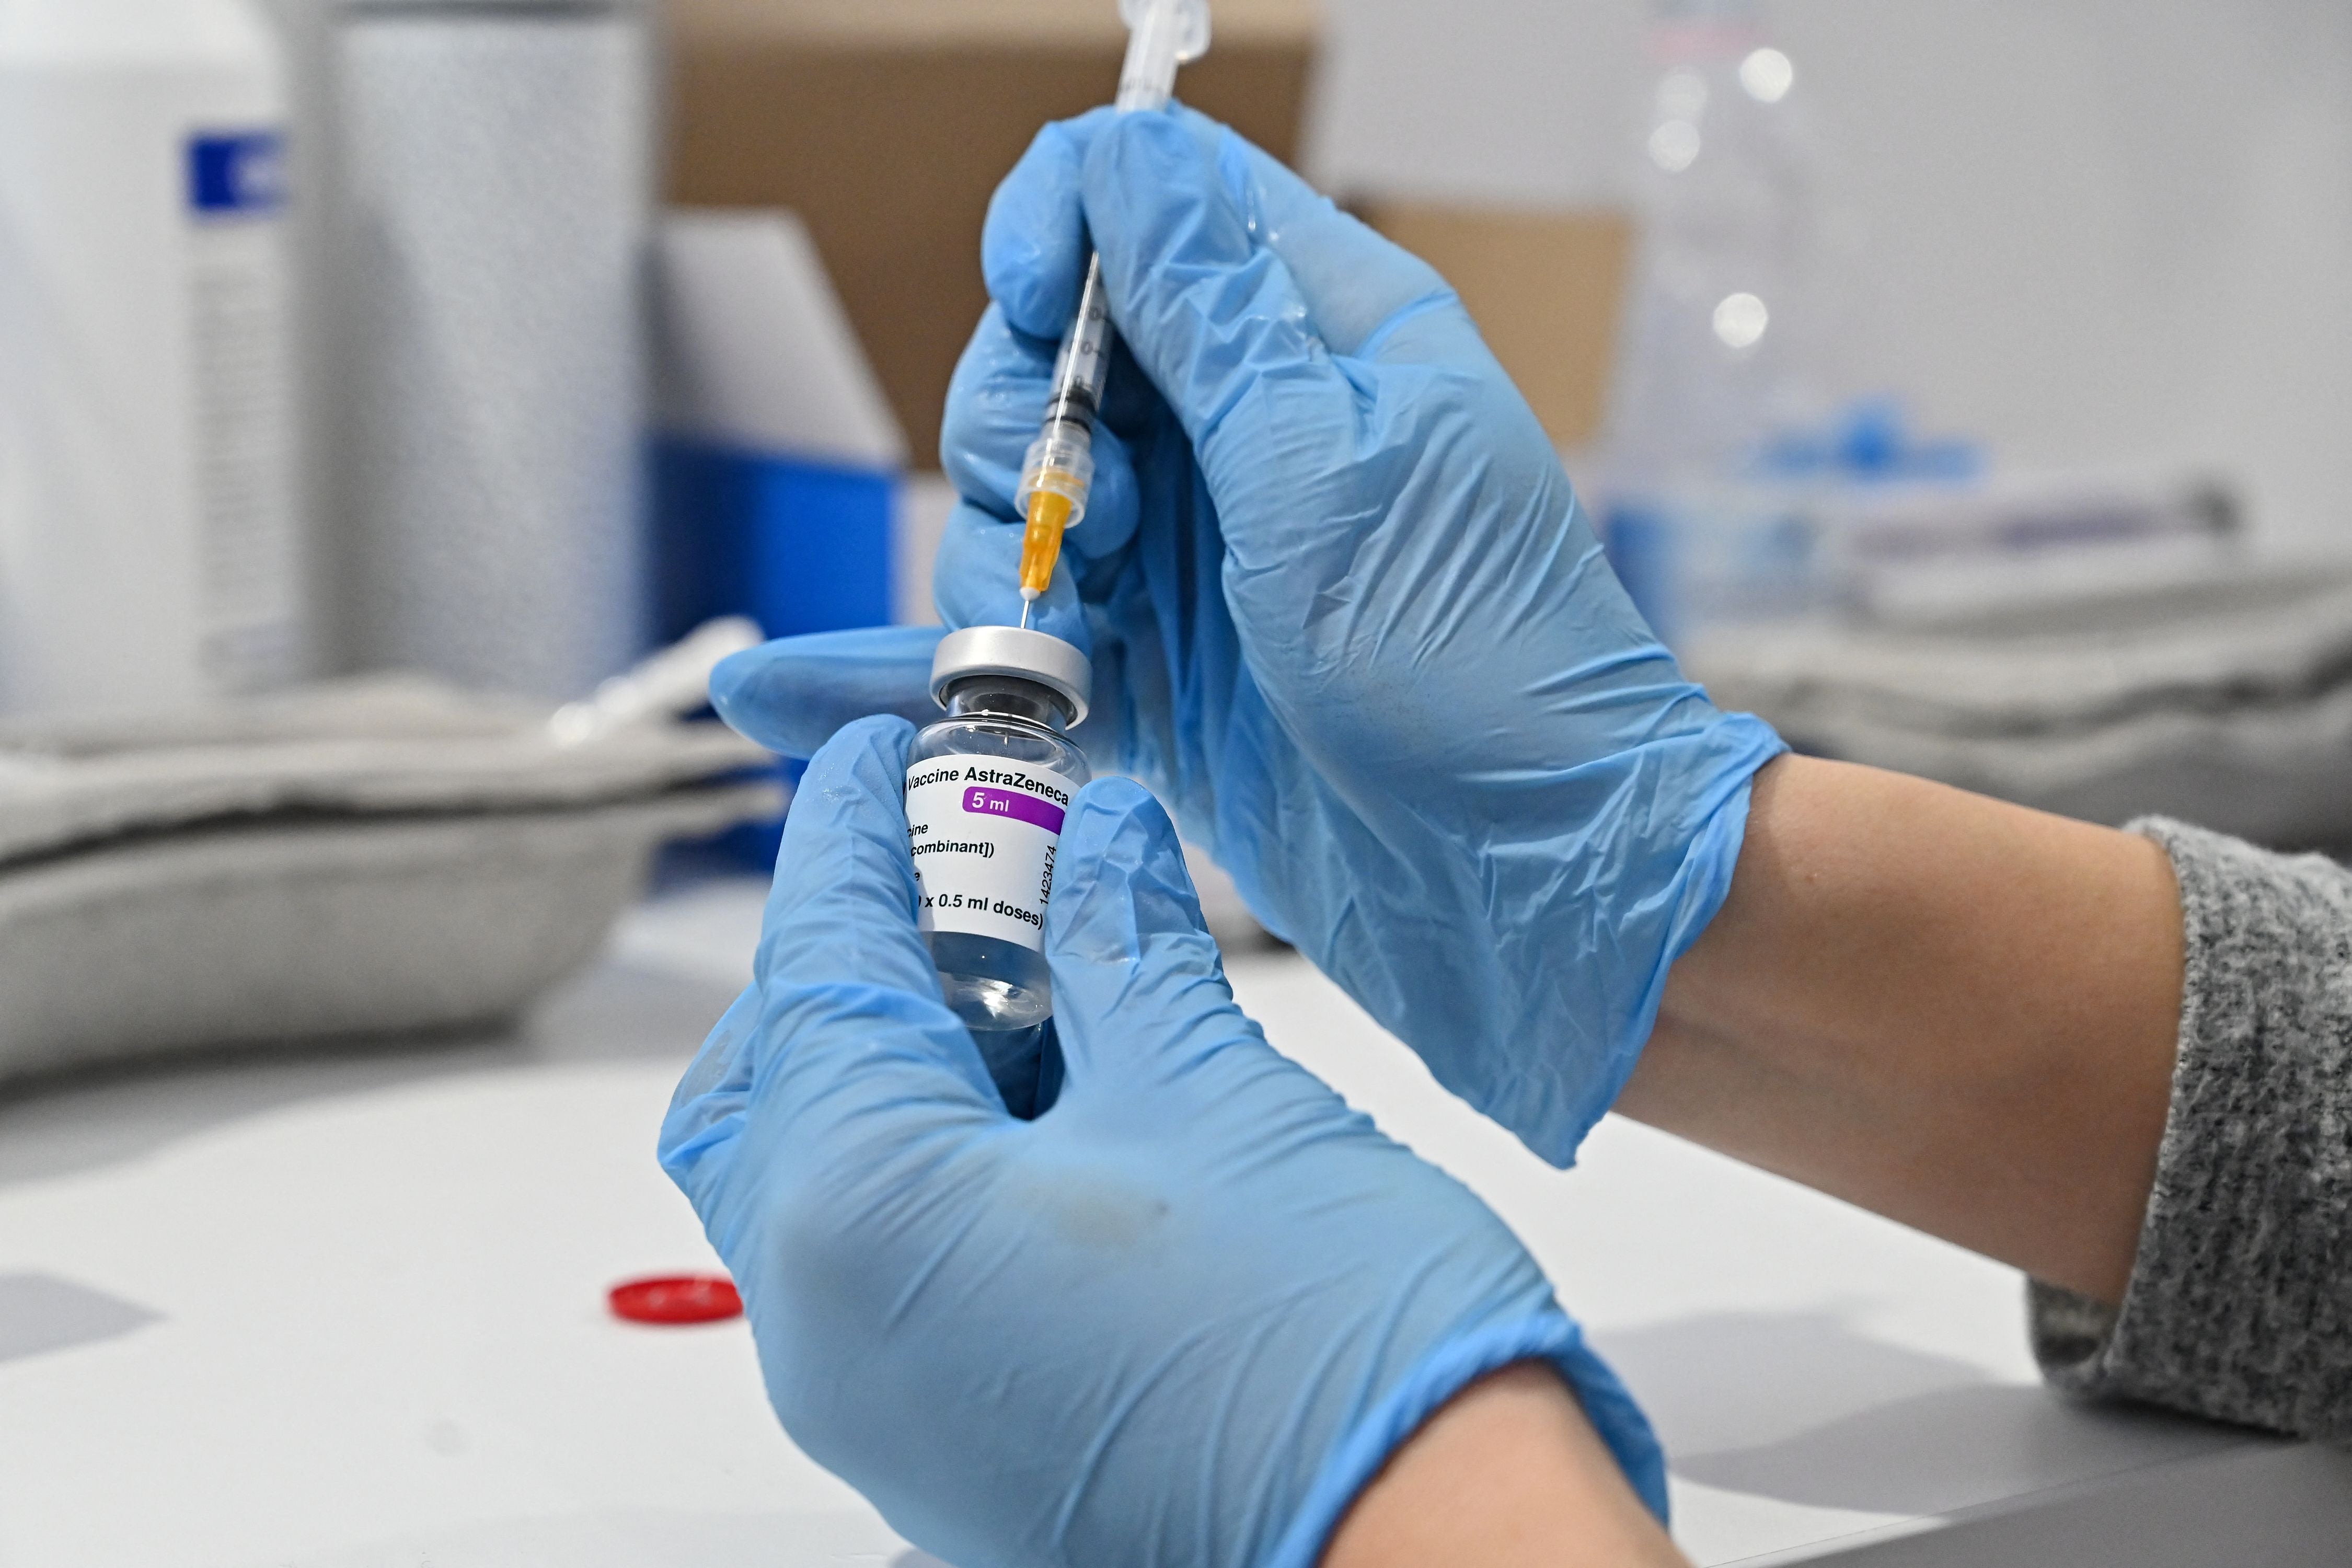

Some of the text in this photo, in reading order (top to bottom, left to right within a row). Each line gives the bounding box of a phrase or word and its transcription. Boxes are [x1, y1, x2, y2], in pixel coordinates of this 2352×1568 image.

[908, 767, 1069, 806] Vaccine AstraZeneca
[972, 792, 1009, 812] 5 ml
[1040, 845, 1056, 904] 1423474
[925, 897, 935, 908] x
[939, 894, 963, 908] 0.5
[967, 897, 988, 911] ml
[993, 901, 1043, 930] doses)
